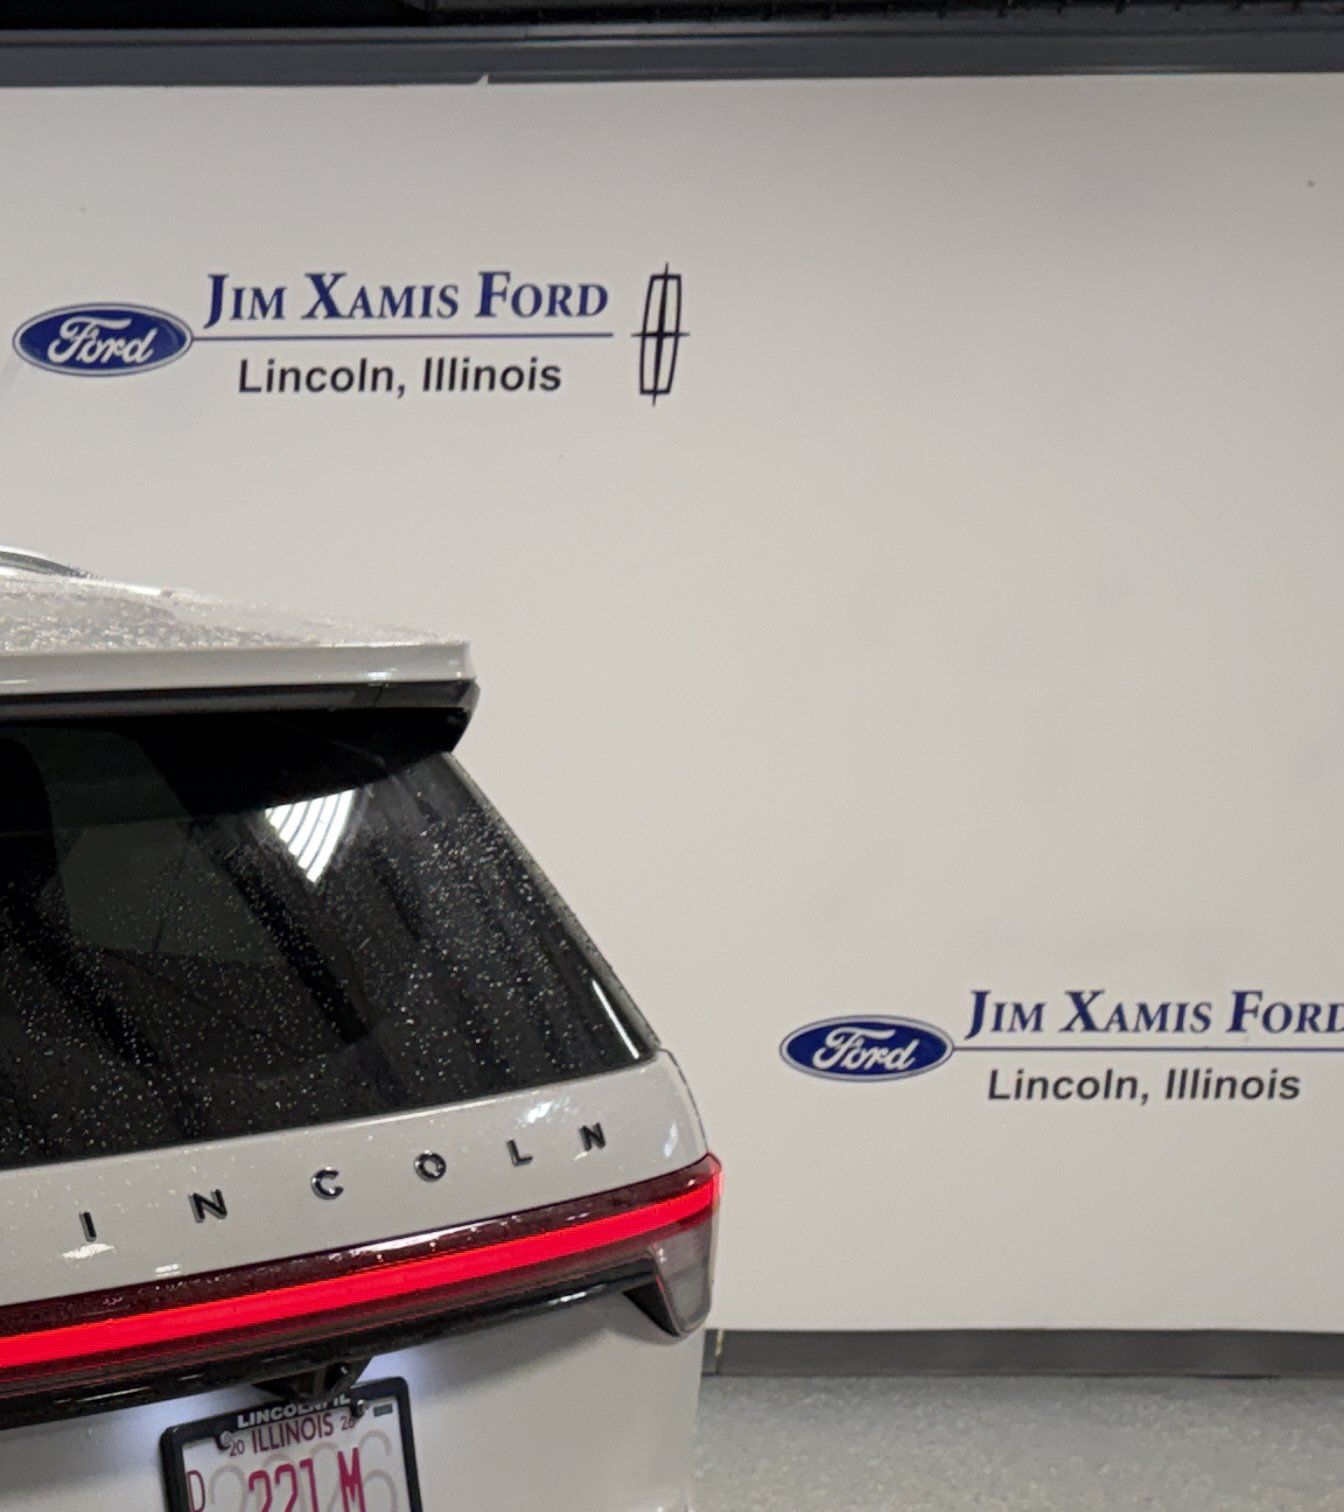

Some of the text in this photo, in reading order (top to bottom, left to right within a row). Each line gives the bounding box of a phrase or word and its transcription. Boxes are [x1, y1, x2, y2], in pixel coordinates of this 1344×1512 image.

[203, 270, 610, 329] JIM XAMIS FORD
[46, 315, 155, 365] Ford
[238, 356, 563, 400] Lincoln, Illinois
[963, 989, 1047, 1041] JIM
[1058, 989, 1214, 1035] XAMIS
[812, 1025, 920, 1071] Ford
[987, 1067, 1302, 1107] Lincoln, Illinois
[251, 1412, 334, 1455] ILLINOIS
